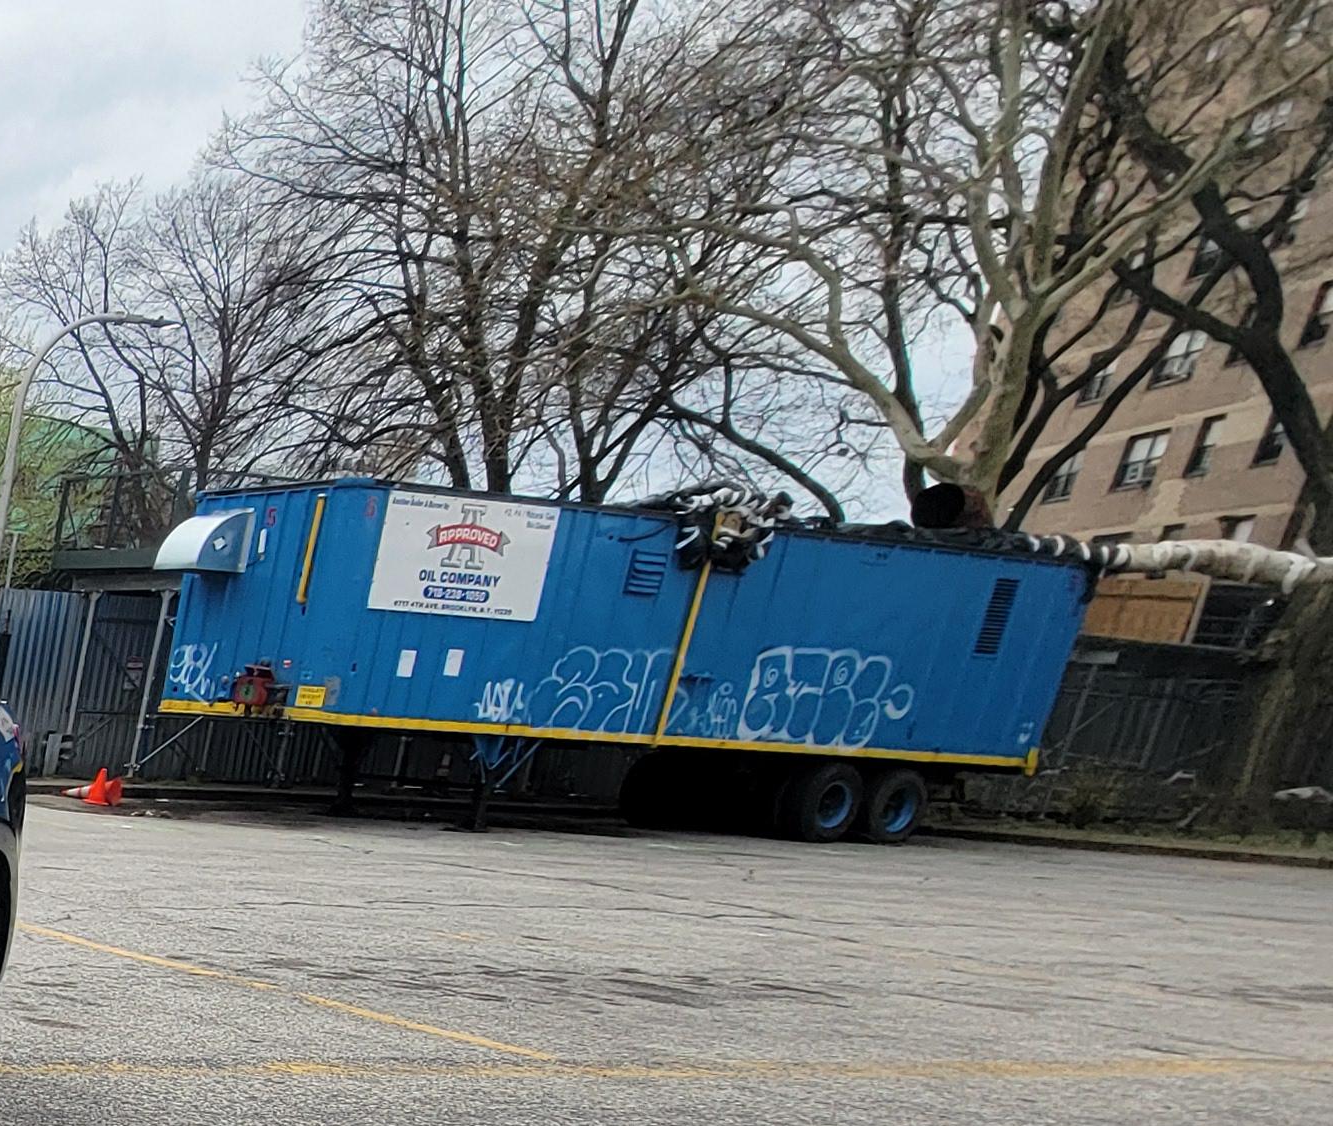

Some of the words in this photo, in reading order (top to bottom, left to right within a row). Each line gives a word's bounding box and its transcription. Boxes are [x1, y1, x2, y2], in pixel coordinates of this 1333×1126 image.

[439, 527, 499, 548] APPROVED
[418, 569, 437, 583] OIL
[439, 571, 502, 588] COMPANY
